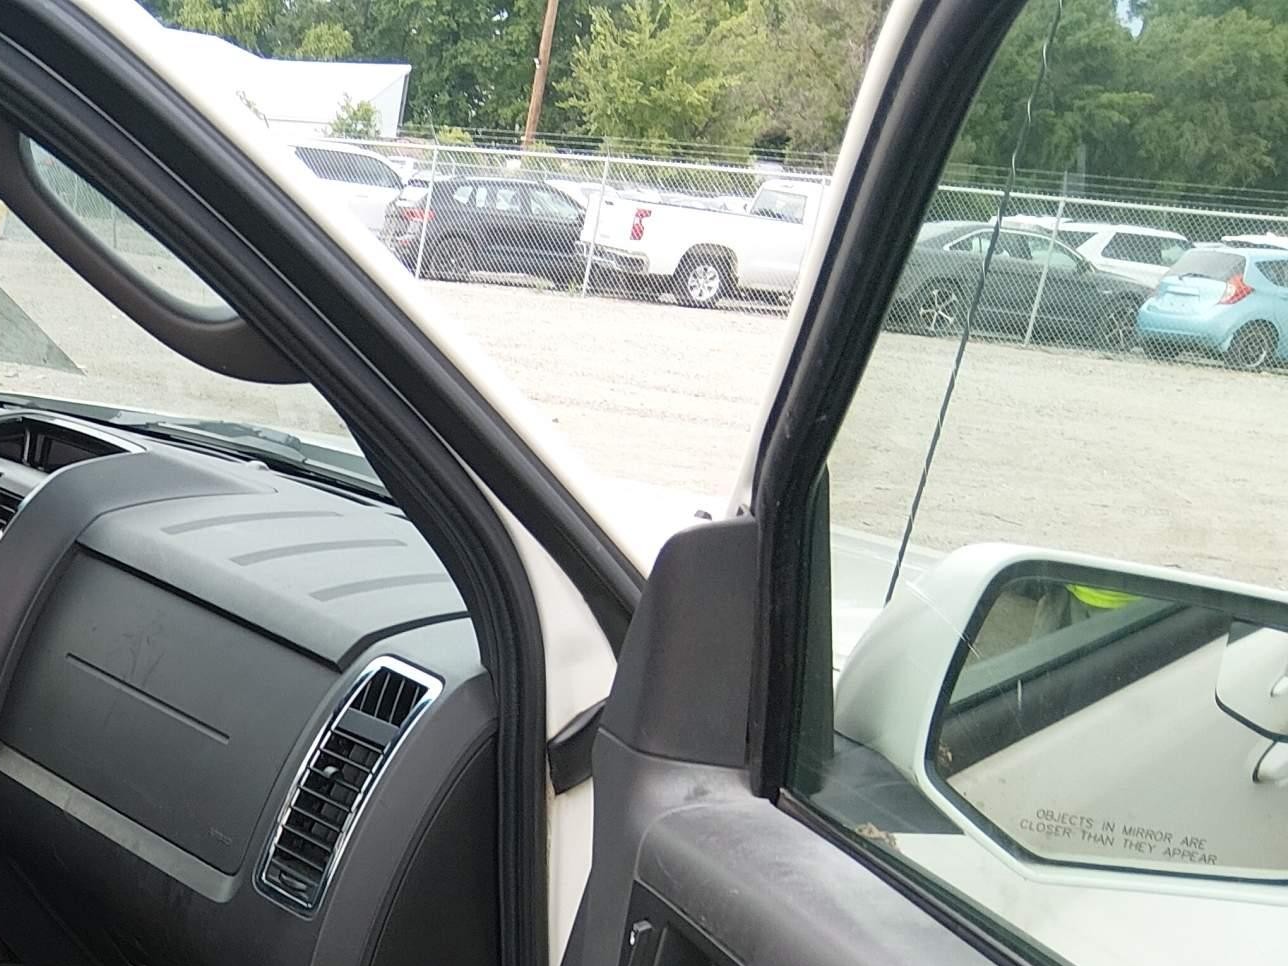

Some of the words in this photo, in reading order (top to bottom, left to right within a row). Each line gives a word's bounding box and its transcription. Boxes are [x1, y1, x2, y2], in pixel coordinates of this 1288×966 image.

[1019, 818, 1073, 838] CLOSER
[1080, 830, 1116, 847] THAN
[1122, 838, 1157, 854] THEY
[1163, 847, 1218, 865] APPEAR
[1036, 808, 1094, 830] OBJECTS
[1102, 821, 1116, 833] IN
[1122, 824, 1173, 844] MIRROR
[1180, 835, 1208, 851] ARE
